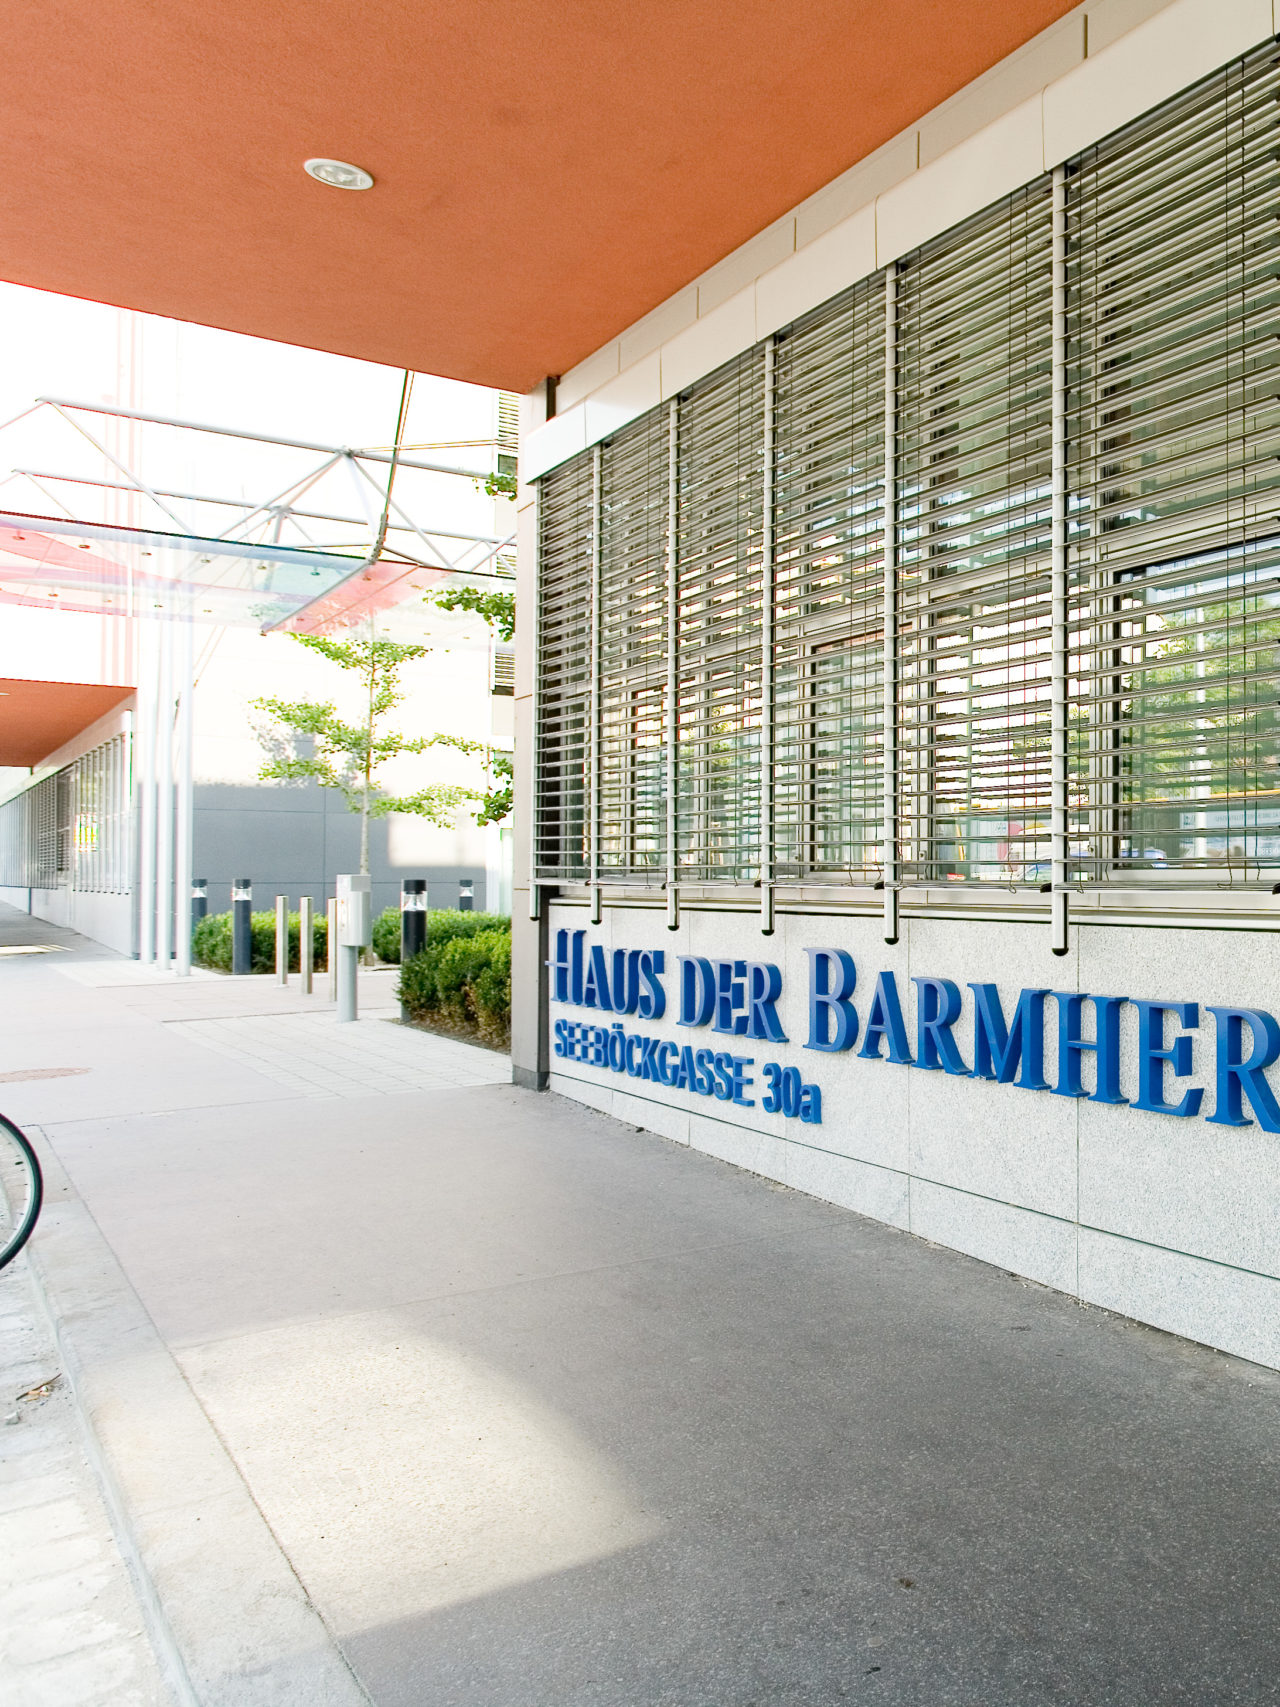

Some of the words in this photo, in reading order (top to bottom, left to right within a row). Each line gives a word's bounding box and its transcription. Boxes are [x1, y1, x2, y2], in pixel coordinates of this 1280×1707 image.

[547, 928, 666, 1020] HAUS
[676, 955, 790, 1043] DER
[554, 1018, 755, 1107] SEEBÖCKGASSE
[762, 1062, 823, 1125] 30a
